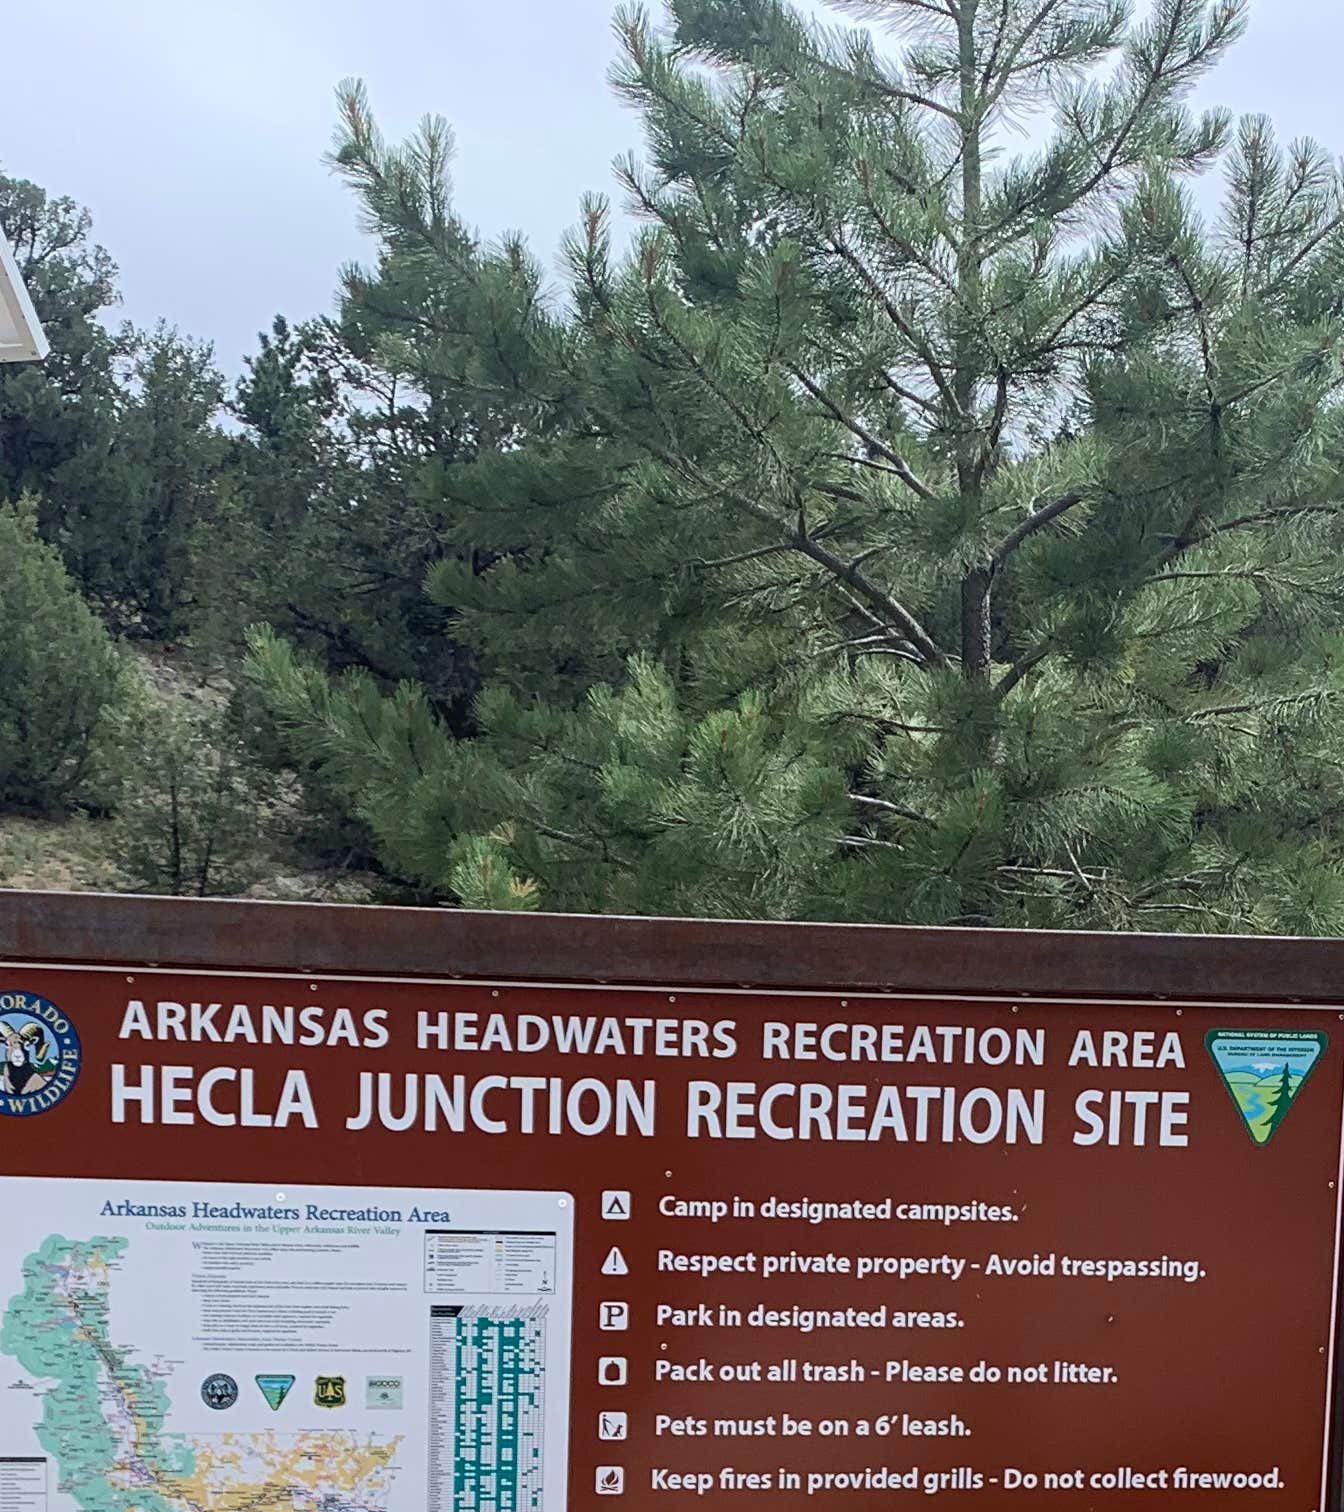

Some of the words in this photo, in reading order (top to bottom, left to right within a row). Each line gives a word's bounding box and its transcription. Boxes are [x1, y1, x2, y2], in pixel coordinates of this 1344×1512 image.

[119, 1001, 389, 1048] ARKANSAS
[417, 1011, 737, 1058] HEADWATERS
[763, 1022, 1045, 1065] RECREATION
[1068, 1030, 1185, 1068] AREA
[7, 1048, 79, 1113] WILDLIFE
[111, 1064, 318, 1128] HECLA
[346, 1072, 655, 1136] JUNCTION
[687, 1081, 1045, 1144] RECREATION
[1073, 1090, 1189, 1147] SITE
[100, 1199, 186, 1218] Arkansas
[192, 1202, 300, 1220] Headwaters
[305, 1205, 402, 1222] Recreation
[407, 1207, 451, 1223] Area
[659, 1196, 728, 1222] Camp
[733, 1196, 754, 1217] in
[760, 1197, 891, 1224] designated
[896, 1200, 1018, 1226] campsites.
[145, 1222, 186, 1231] Outdoor
[189, 1223, 241, 1232] Adventures
[255, 1224, 270, 1232] the
[272, 1224, 301, 1235] Upper
[304, 1225, 345, 1234] Arkansas
[347, 1226, 371, 1234] River
[374, 1226, 401, 1237] Valley
[658, 1250, 756, 1277] Respect
[763, 1251, 851, 1278] private
[857, 1255, 966, 1280] property
[985, 1253, 1055, 1275] Avoid
[1061, 1256, 1206, 1282] trespassing.
[657, 1304, 713, 1326] Park
[719, 1305, 741, 1326] in
[748, 1304, 886, 1332] designated
[892, 1312, 964, 1328] areas.
[656, 1359, 714, 1381] Pack
[719, 1362, 762, 1381] out
[767, 1359, 796, 1381] all
[802, 1360, 864, 1381] trash
[886, 1360, 964, 1382] Please
[969, 1361, 1001, 1382] do
[1008, 1364, 1048, 1382] not
[1054, 1361, 1117, 1383] litter.
